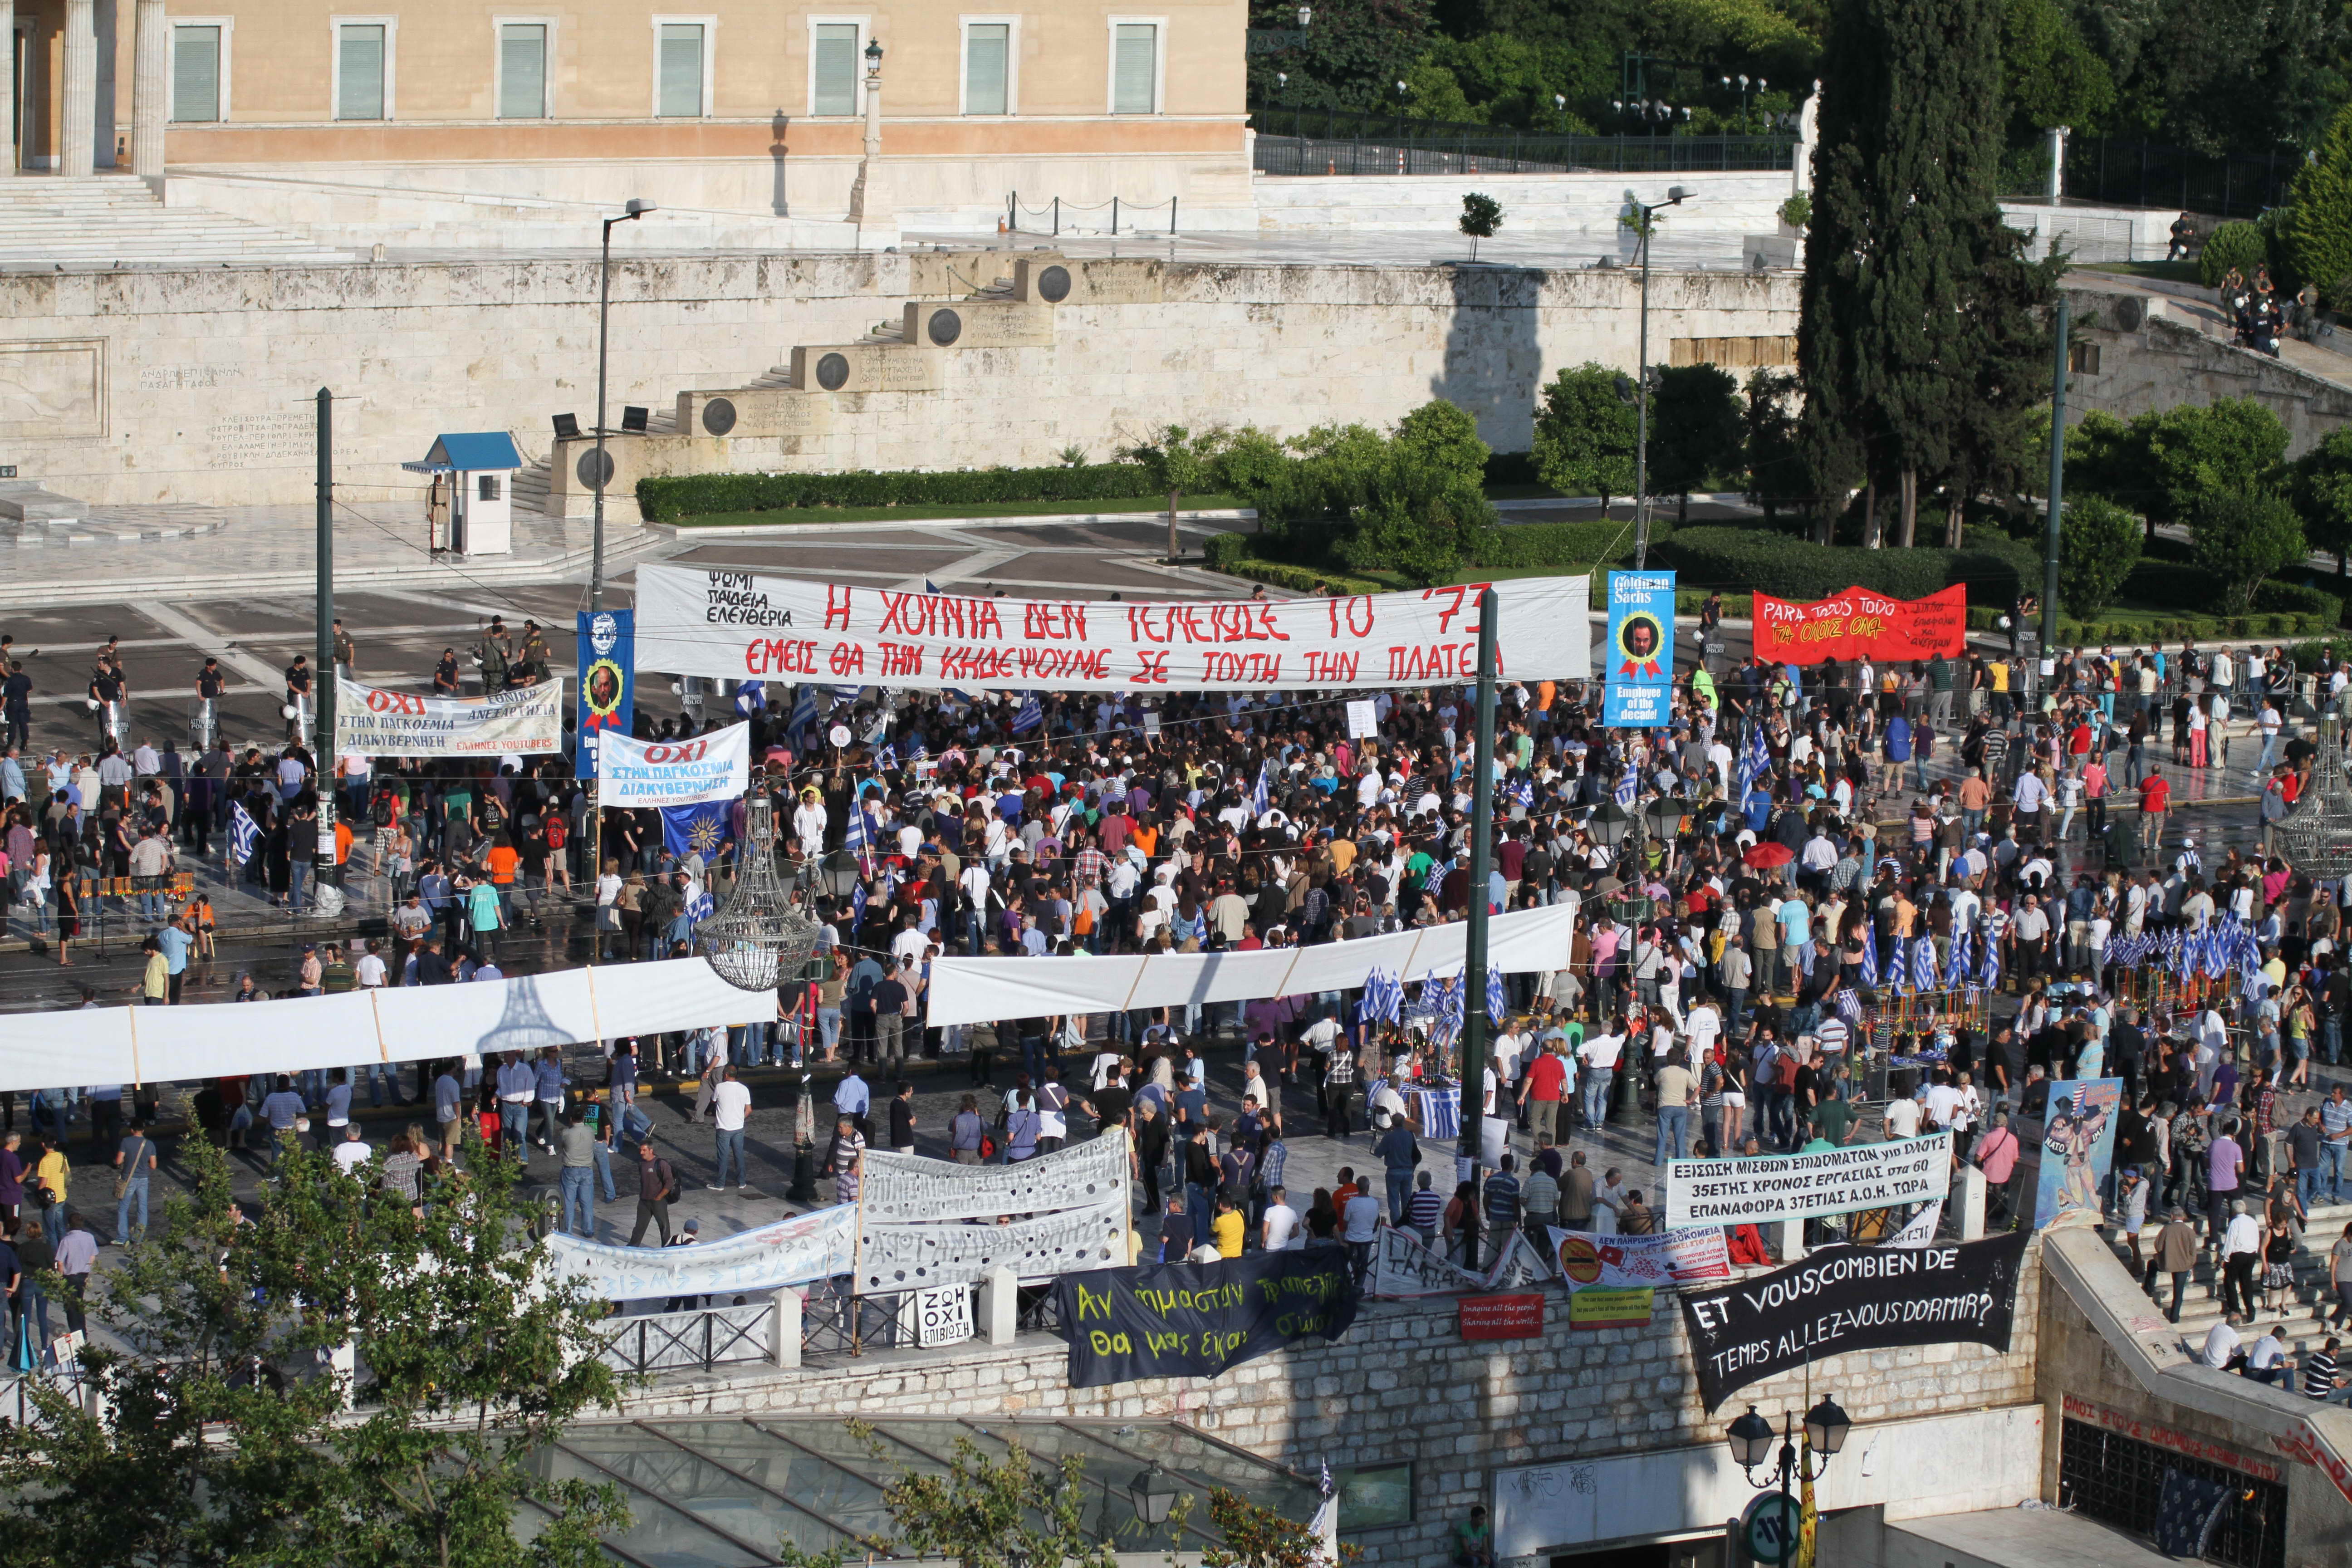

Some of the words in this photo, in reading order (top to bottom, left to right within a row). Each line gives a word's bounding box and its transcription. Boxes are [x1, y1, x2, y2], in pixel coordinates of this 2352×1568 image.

[708, 570, 754, 588] ΨΩΜΙ
[1614, 576, 1669, 591] Goldman
[706, 590, 768, 608] ΠΑΙΔΕΙΑ
[1614, 589, 1651, 603] Sachs
[706, 606, 793, 627] ΕΛΕΥΘΕΡΙΑ
[825, 584, 851, 631] Η
[1024, 603, 1086, 641] ΔΕΝ
[1764, 603, 1806, 622] PARA
[1811, 598, 1852, 617] TODOS
[1859, 597, 1895, 616] TODO
[1801, 618, 1845, 642] ΟΛΟΥΣ
[1850, 617, 1886, 639] ΟΛΑ
[745, 639, 818, 675] ΕΜΕΙΣ
[829, 642, 864, 678] ΘΑ
[878, 642, 925, 678] ΤΗΝ
[939, 646, 1112, 681] ΚΗΔΕΨΟΥΜΕ
[1129, 650, 1170, 684] ΣΕ
[1202, 651, 1282, 684] ΤΟΥΤΗ
[1304, 650, 1361, 684] ΤΗΝ
[1617, 686, 1661, 698] Employee
[367, 690, 426, 715] ΟΧΙ
[486, 690, 537, 706] ΕΘΝΙΚΗ
[468, 704, 556, 720] ΑΝΕΞΑΡΤΗΣΙΑ
[1627, 698, 1637, 709] of
[1639, 698, 1653, 709] the
[339, 715, 375, 728] ΣΤΗΝ
[381, 717, 454, 730] ΠΑΓΚΟΣΜΙΑ
[1621, 709, 1657, 720] decade!
[348, 734, 445, 748] ΔΙΑΚΥΒΕΡΝΗΣΗ
[457, 740, 497, 751] ΕΛΛΗΝΕΣ
[500, 739, 552, 749] YOUTUBERS
[644, 740, 707, 764] ΟΧΙ
[612, 766, 651, 779] ΣΤΗΝ
[652, 760, 734, 779] ΠΑΓΚΟΣΜΙΑ
[619, 776, 728, 795] ΔΙΑΚΥΒΕΡΝΗΣΗ
[672, 793, 709, 803] YOUTUBERS
[2086, 1083, 2116, 1095] GLOBAL
[1675, 1162, 1732, 1179] ΕΞΙΣΩΣΗ
[1736, 1159, 1788, 1175] ΜΙΣΘΩΝ
[1793, 1148, 1879, 1170] ΕΠΙΔΟΜΑΤΩΝ
[1904, 1136, 1946, 1155] ΟΛΟΥΣ
[1691, 1181, 1748, 1198] 35ΕΤΗΣ
[1752, 1176, 1812, 1193] ΧΡΟΝΟΣ
[1816, 1168, 1883, 1186] ΕΡΓΑΣΙΑΣ
[1887, 1165, 1910, 1176] στα
[1913, 1160, 1929, 1173] 60
[1690, 1198, 1785, 1219] ΕΠΑΝΑΦΟΡΑ
[1789, 1191, 1846, 1210] 37ΕΤΙΑΣ
[1850, 1186, 1890, 1202] Α.Ο.Η.
[1892, 1178, 1929, 1195] ΤΩΡΑ
[1598, 1237, 1615, 1245] ΔΕΝ
[1661, 1243, 1688, 1252] ΑΝΗΚΕΙ
[1707, 1235, 1722, 1243] ΛΑΟ
[1677, 1252, 1706, 1260] ΕΠΙΤΡΟΠΕΣ
[925, 1287, 964, 1309] ΖΩΗ
[1692, 1296, 1730, 1330] ET
[1926, 1249, 1959, 1270] DE
[1078, 1283, 1112, 1321] Αν
[1463, 1304, 1491, 1316] Imagine
[1516, 1303, 1536, 1315] people
[925, 1305, 963, 1327] ΟΧΙ
[1463, 1317, 1490, 1330] Sharing
[1504, 1317, 1514, 1325] the
[1516, 1317, 1539, 1326] world...
[925, 1322, 969, 1344] ΕΠΙΒΙΩΣΗ
[1146, 1330, 1190, 1359] μας
[1712, 1339, 1769, 1378] TEMPS
[2064, 1395, 2095, 1419] ΟΛΟΙ
[2102, 1409, 2142, 1437] ΣΤΟΥΣ
